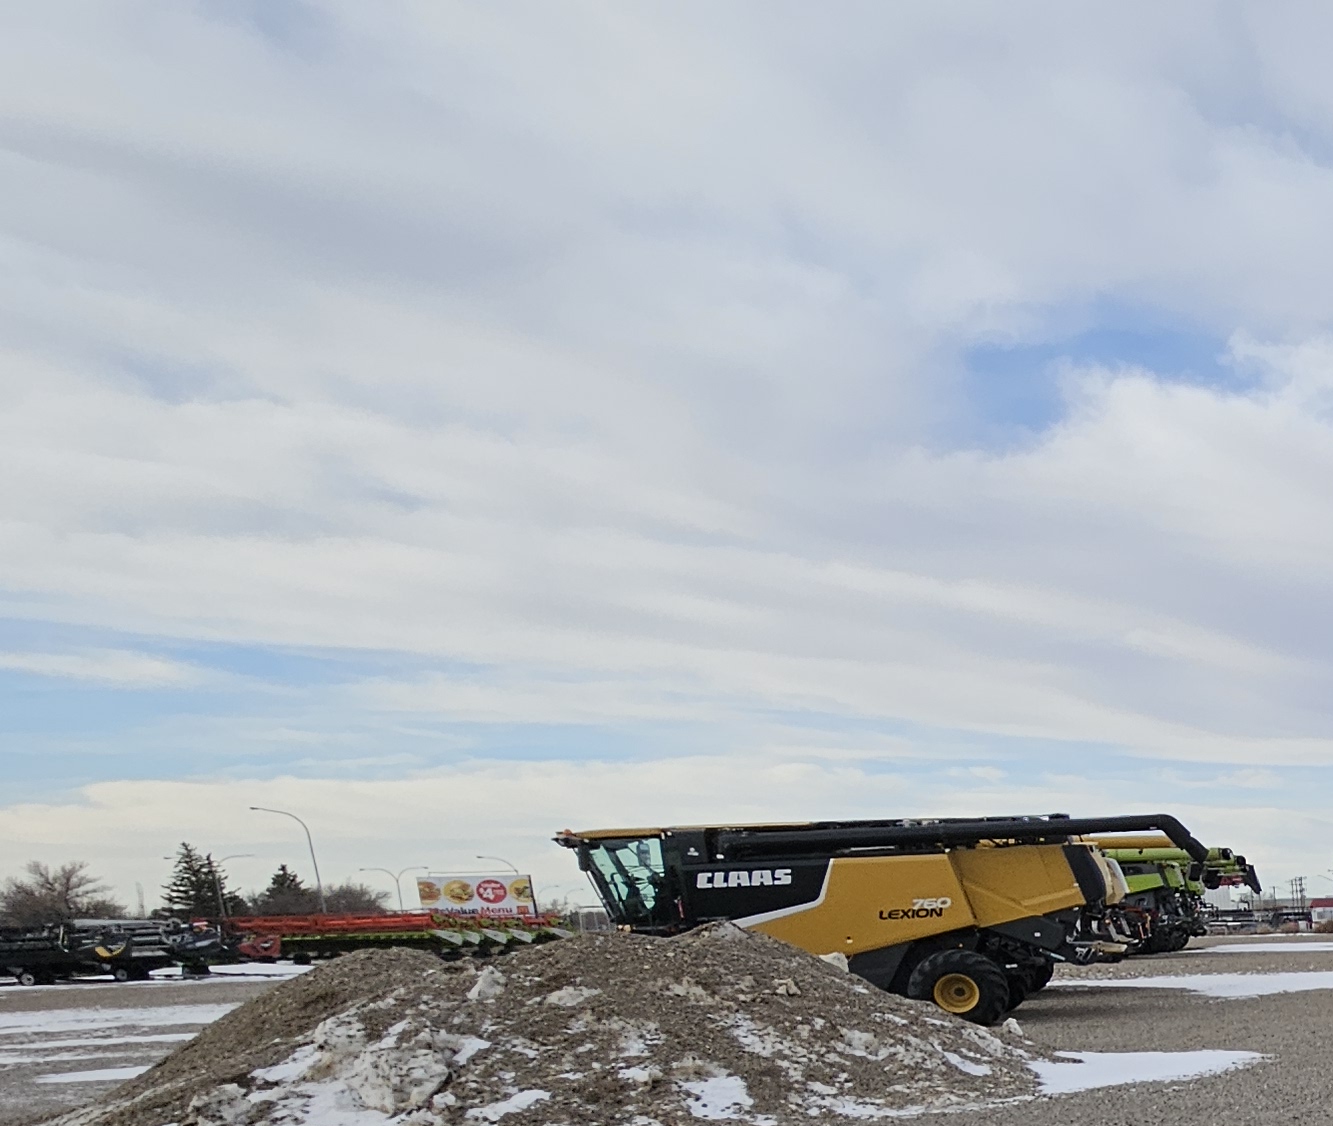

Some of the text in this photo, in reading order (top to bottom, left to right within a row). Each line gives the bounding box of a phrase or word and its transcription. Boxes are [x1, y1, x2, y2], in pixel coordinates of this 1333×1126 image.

[696, 868, 792, 889] CLAAS
[912, 897, 952, 910] 760
[878, 907, 943, 920] LEXION
